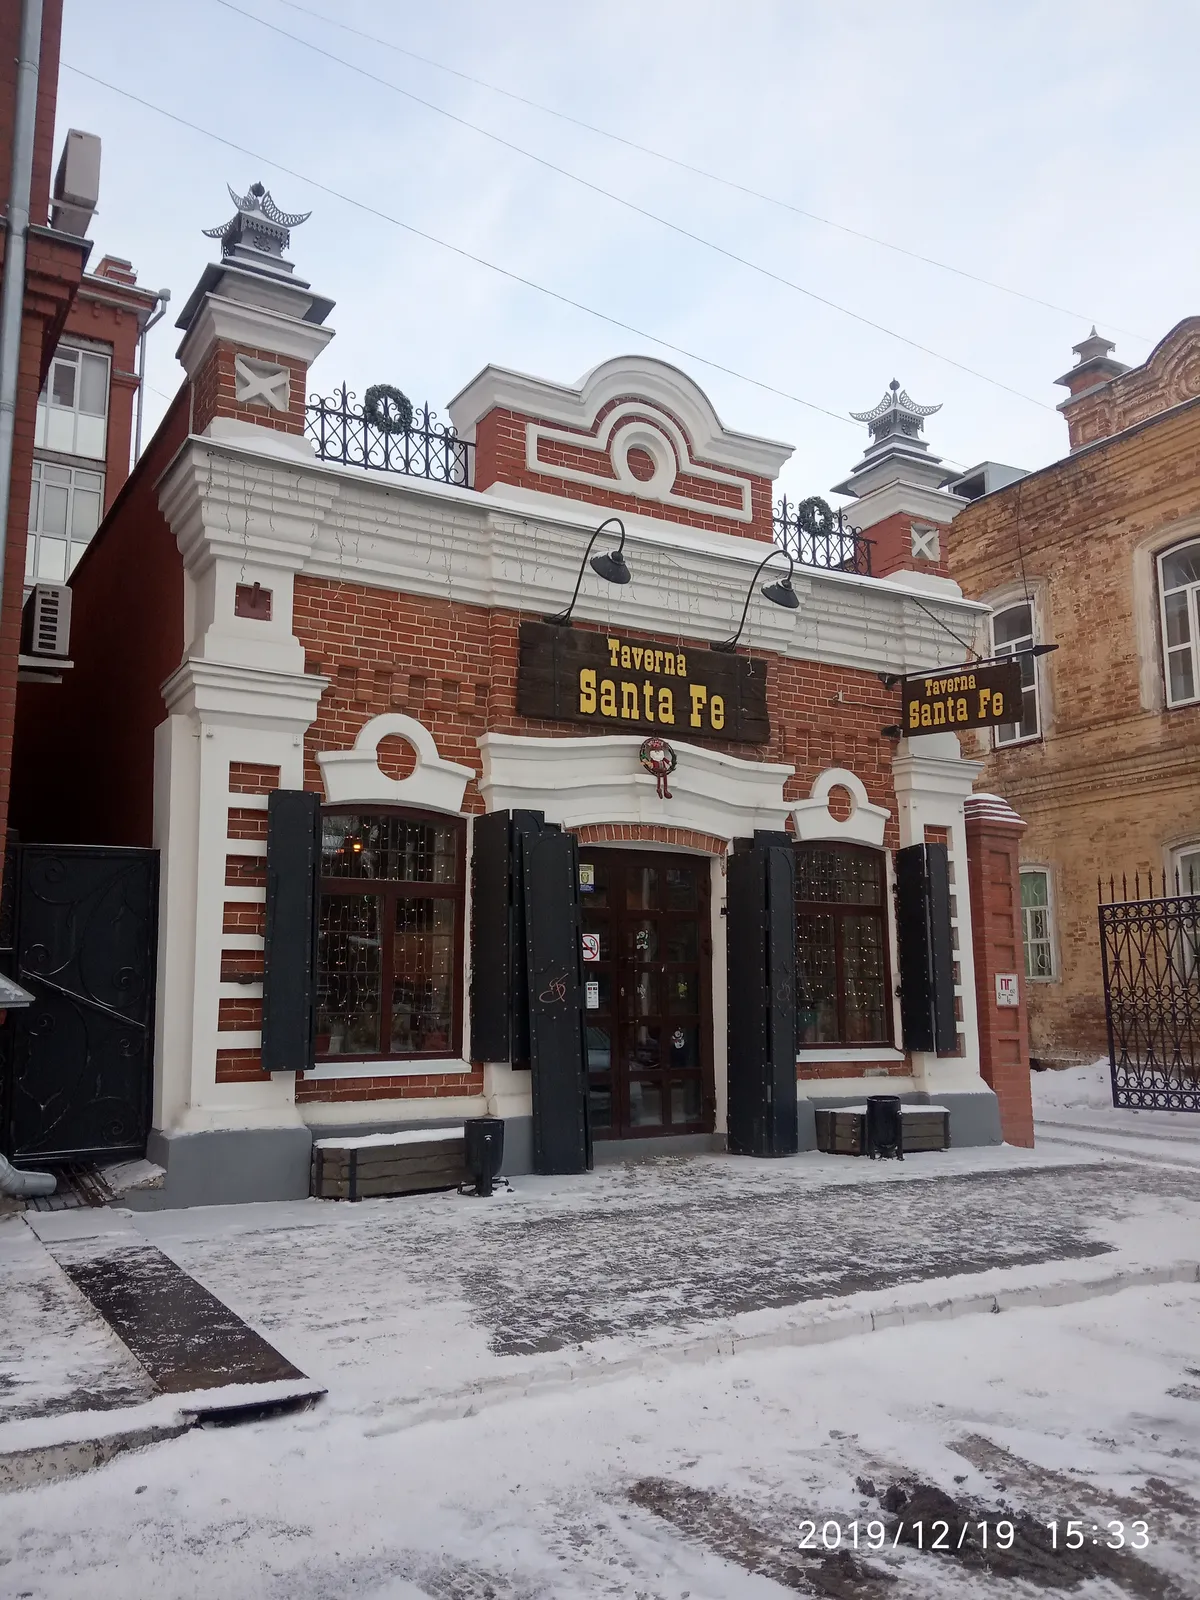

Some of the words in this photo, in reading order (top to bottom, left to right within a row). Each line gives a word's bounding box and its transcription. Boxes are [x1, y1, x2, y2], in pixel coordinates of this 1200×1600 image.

[607, 638, 687, 678] Taverna
[579, 667, 675, 725] Santa
[689, 683, 725, 730] Fe
[925, 674, 976, 697] Taverna
[909, 696, 968, 729] Santa
[978, 688, 1004, 719] Fe
